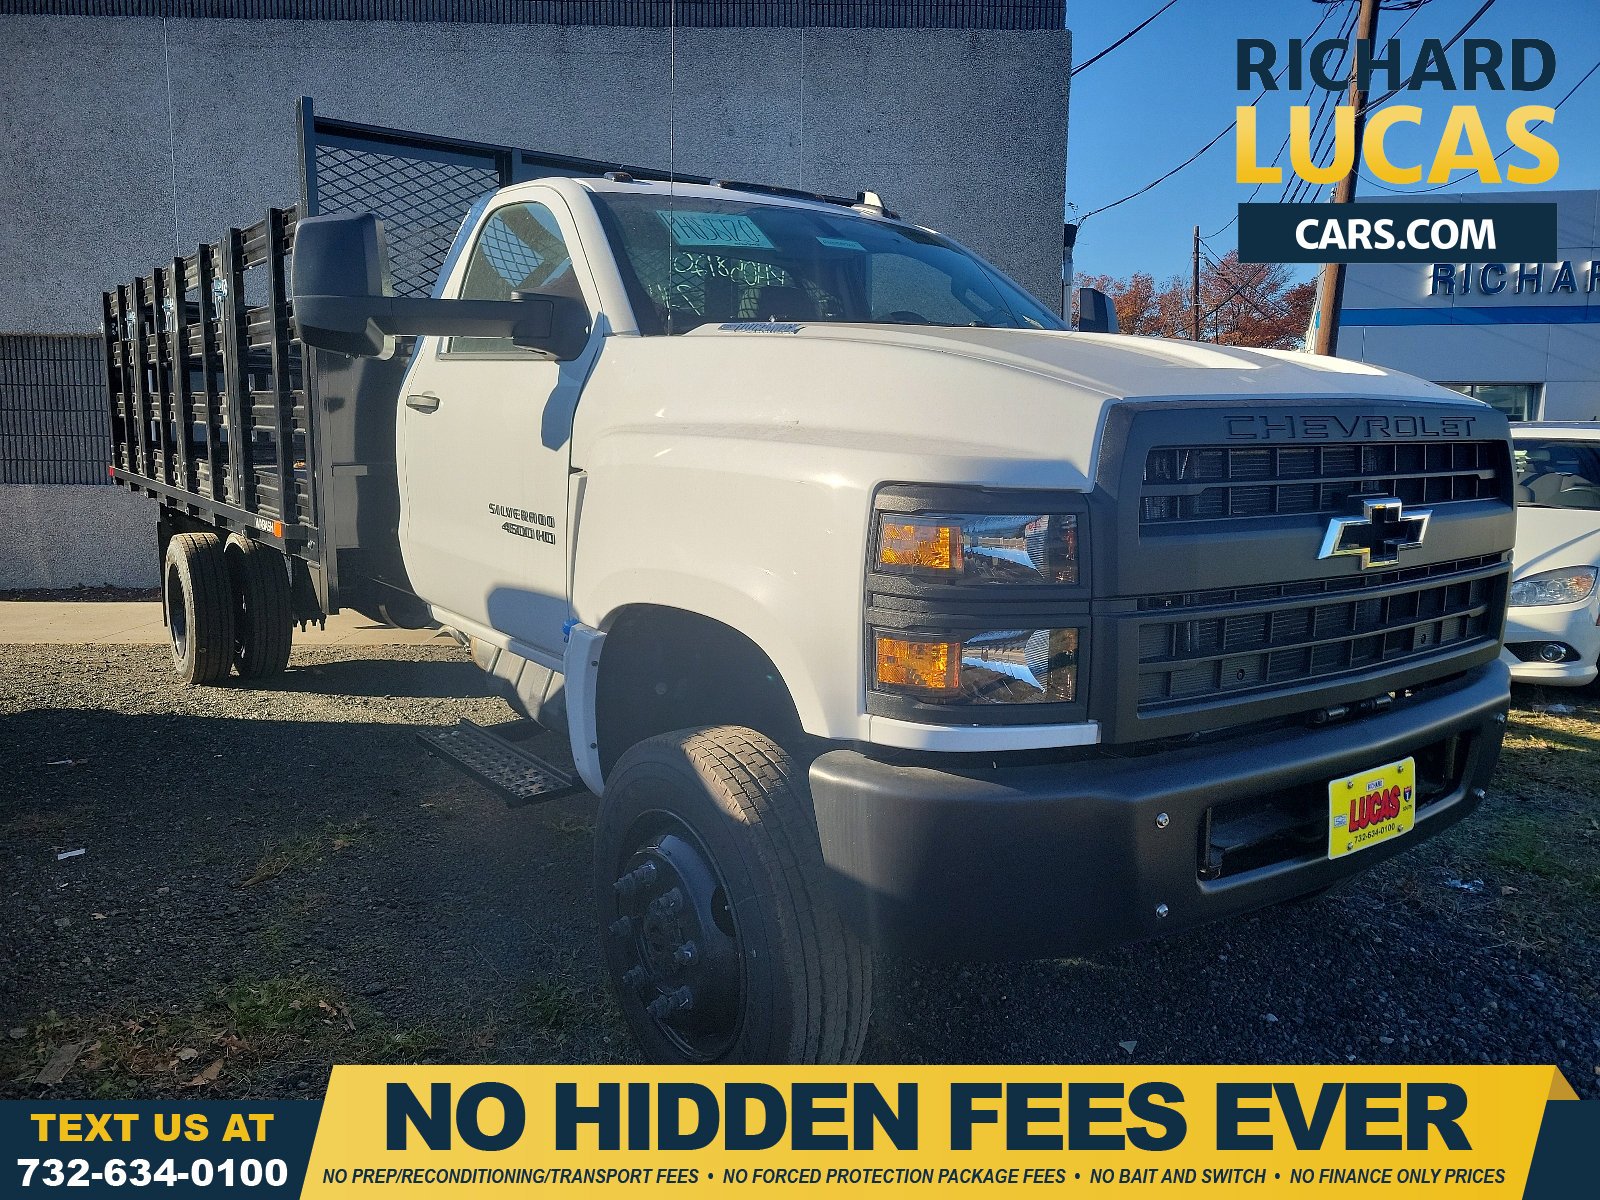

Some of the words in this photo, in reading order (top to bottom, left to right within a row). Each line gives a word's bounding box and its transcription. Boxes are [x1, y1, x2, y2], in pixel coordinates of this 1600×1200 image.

[1224, 415, 1476, 440] CHEVROLET
[488, 502, 556, 528] SILVERADO
[501, 521, 536, 540] 4500
[535, 529, 556, 546] HD
[1348, 784, 1401, 833] LUCAS
[1354, 823, 1396, 844] 732-634-0100
